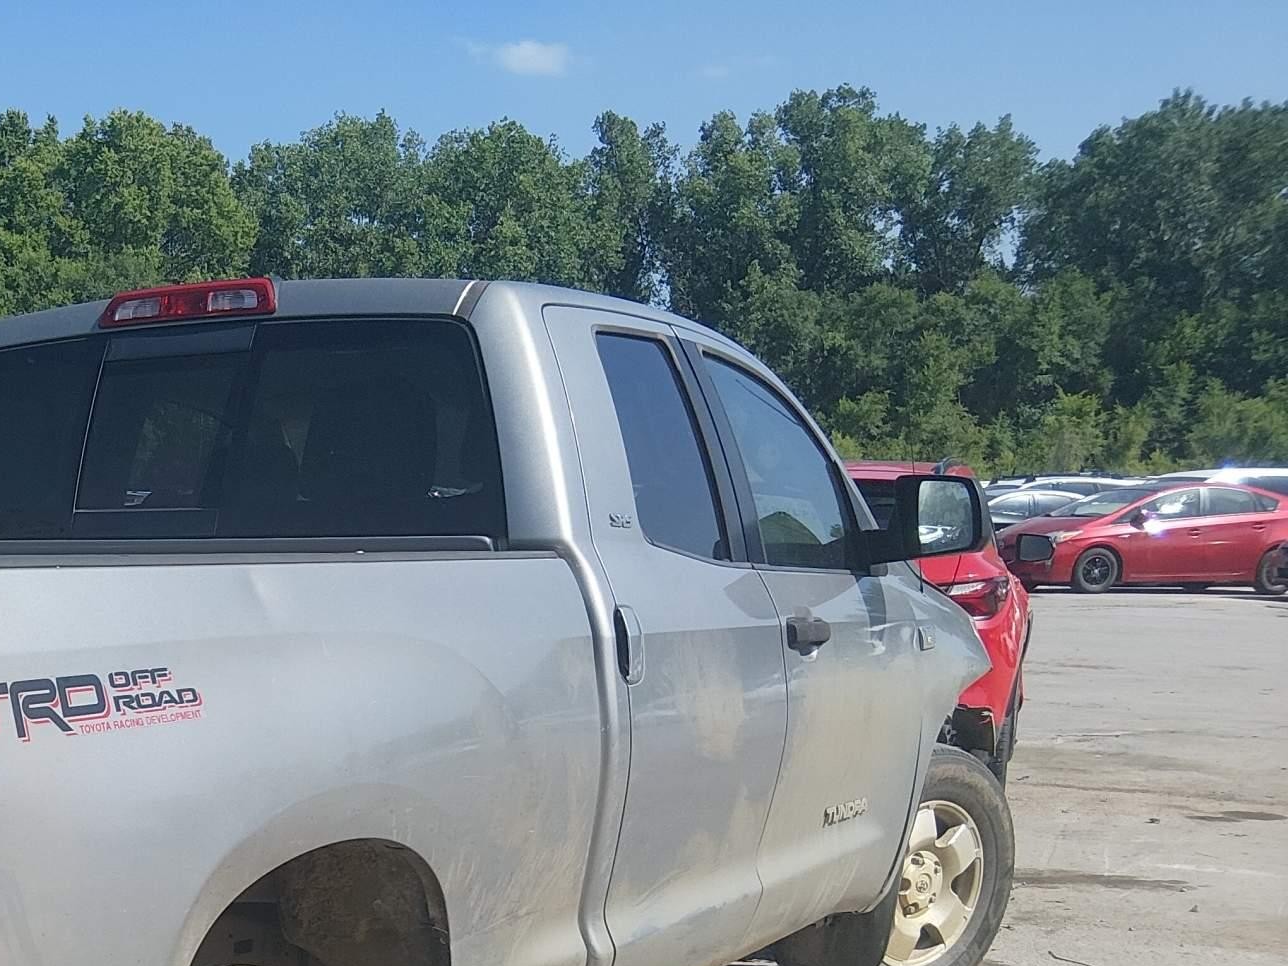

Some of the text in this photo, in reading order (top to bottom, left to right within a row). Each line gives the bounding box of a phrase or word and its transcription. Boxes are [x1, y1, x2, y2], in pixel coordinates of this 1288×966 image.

[109, 668, 172, 691] OFF
[113, 688, 202, 715] ROAD
[80, 710, 202, 735] TOYOTA RACING DEVELOPMENT
[820, 797, 868, 827] TUNDRA
